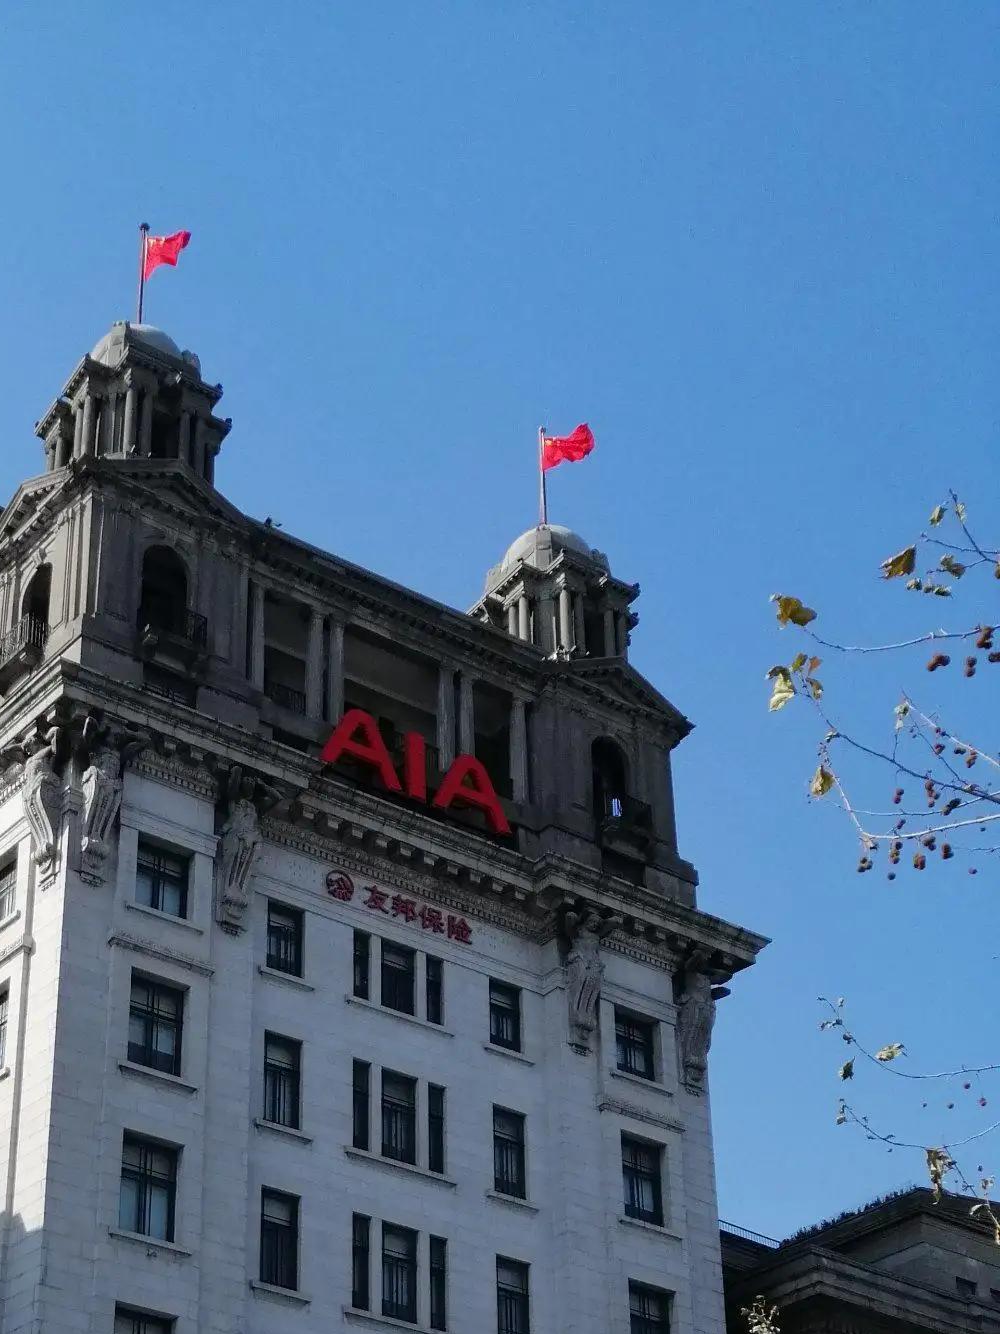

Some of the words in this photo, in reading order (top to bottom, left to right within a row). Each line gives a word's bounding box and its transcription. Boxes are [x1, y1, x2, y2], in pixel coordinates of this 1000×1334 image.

[321, 708, 511, 836] AIA
[363, 885, 473, 944] 友邦保险
